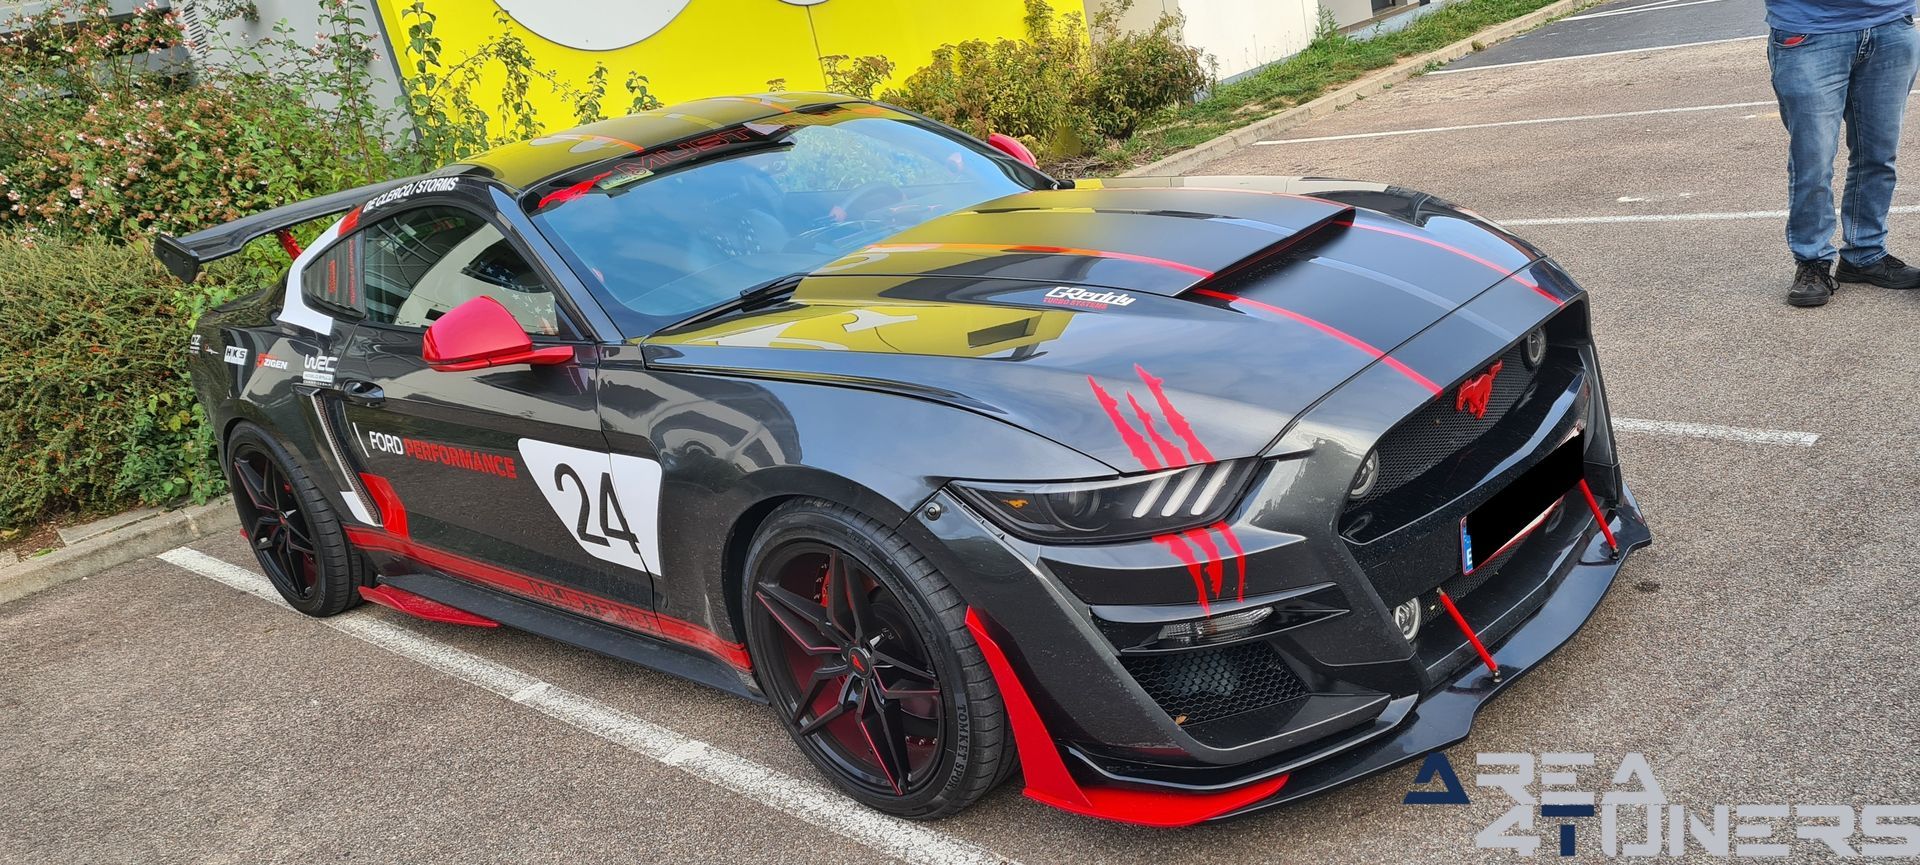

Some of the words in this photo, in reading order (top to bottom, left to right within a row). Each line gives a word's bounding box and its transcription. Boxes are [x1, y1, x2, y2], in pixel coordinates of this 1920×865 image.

[375, 183, 414, 207] CLERCQ
[416, 177, 459, 194] STORMS
[1045, 286, 1137, 307] GReddy
[226, 348, 246, 359] HKS
[369, 430, 403, 456] FORD
[403, 437, 518, 479] PERFORMANCE
[553, 463, 640, 555] 24
[956, 704, 971, 761] TOMKET
